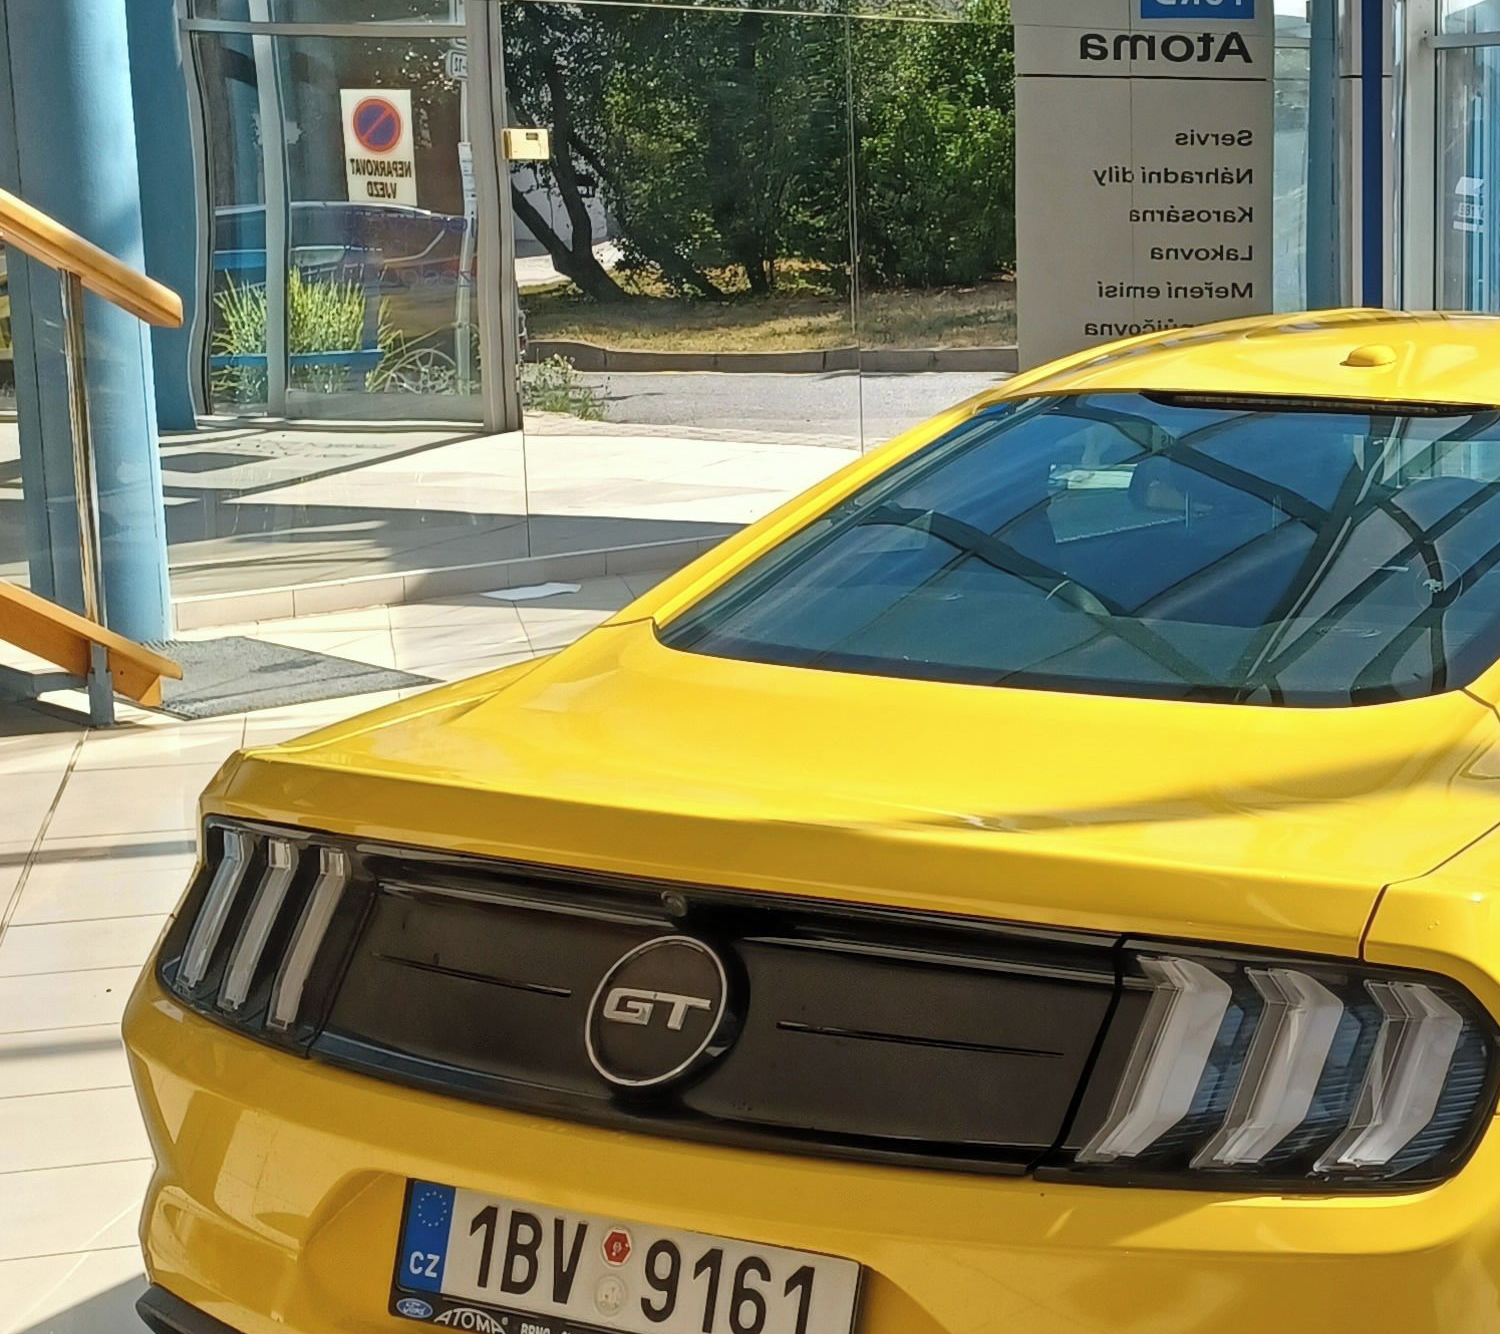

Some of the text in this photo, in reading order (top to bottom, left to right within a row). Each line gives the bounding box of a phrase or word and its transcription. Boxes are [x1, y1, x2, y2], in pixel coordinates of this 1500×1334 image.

[603, 987, 711, 1030] GT
[409, 1250, 441, 1279] CZ
[470, 1205, 589, 1304] 1BV
